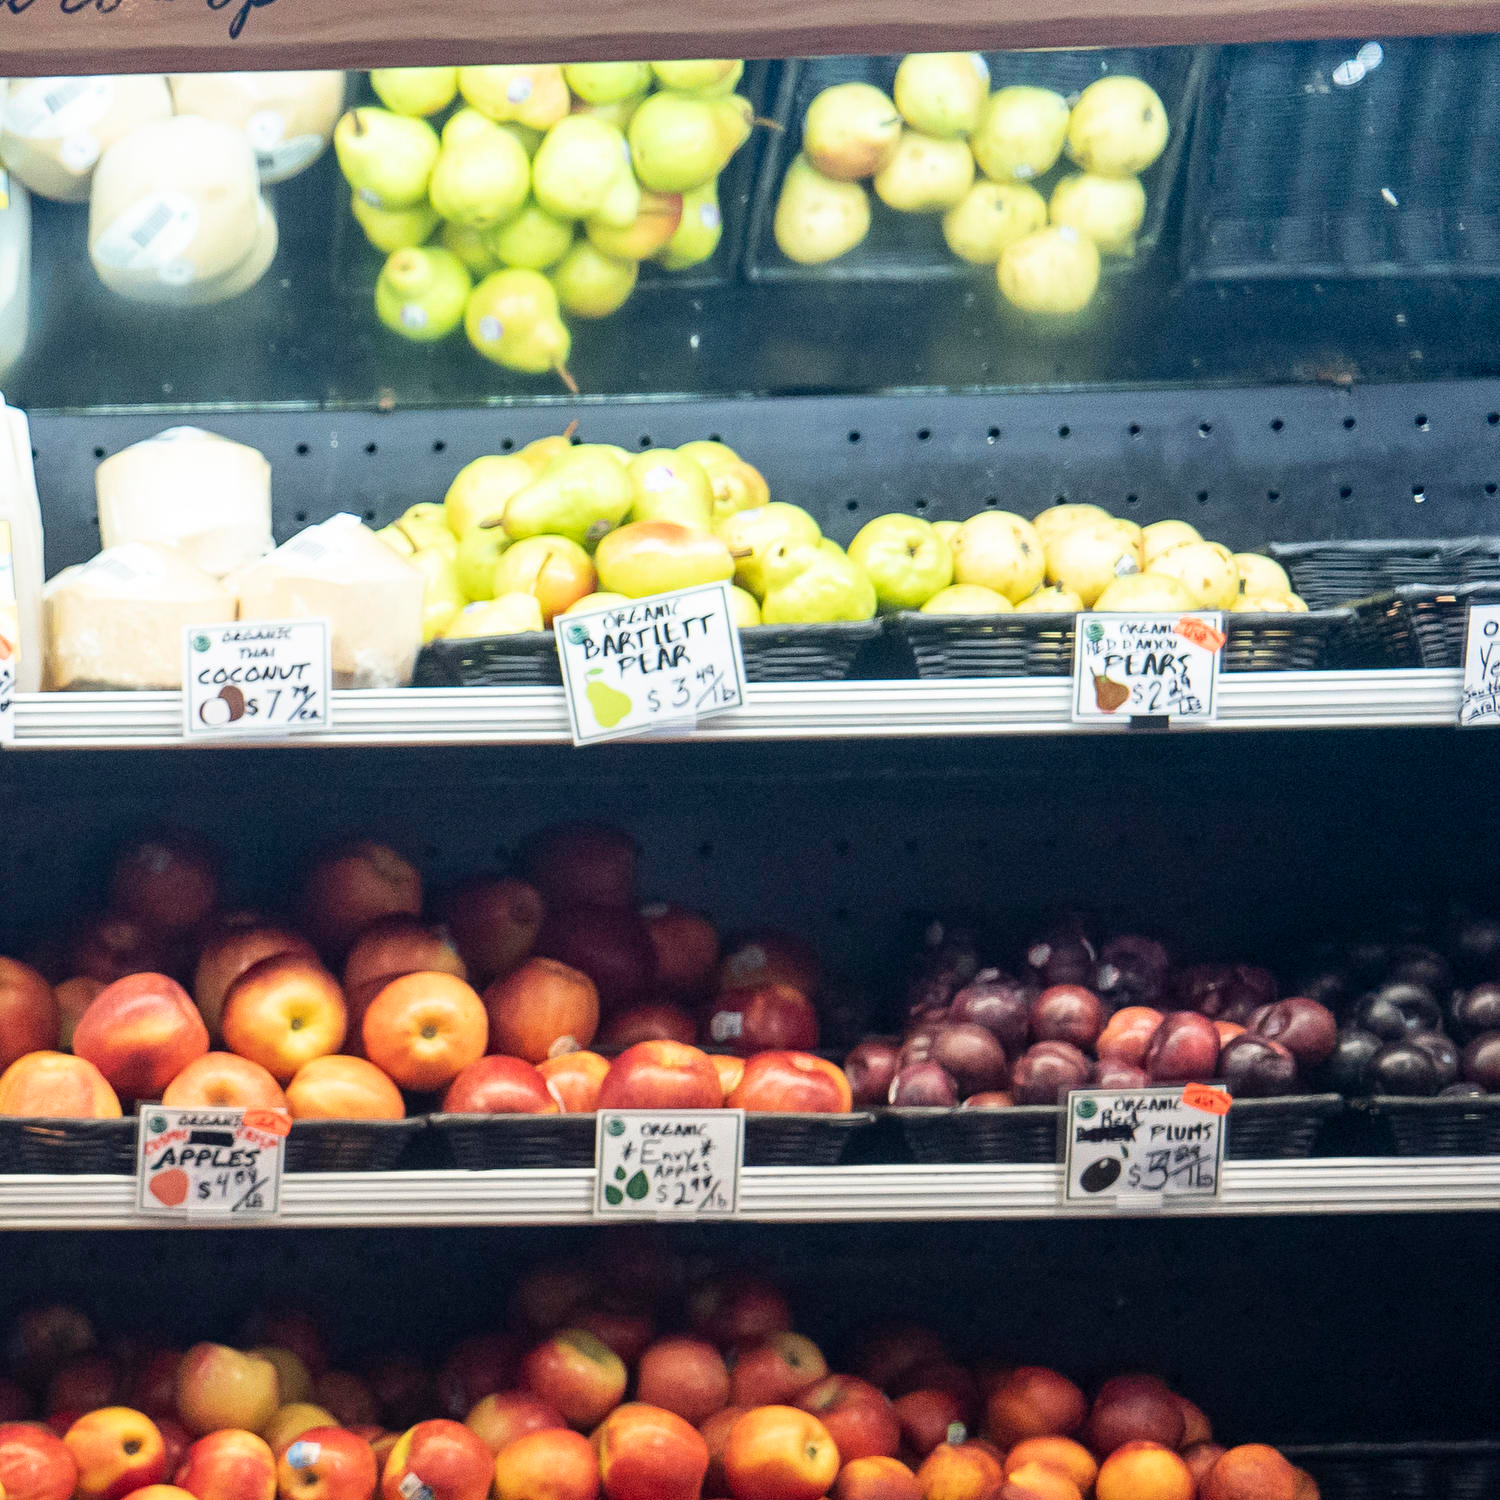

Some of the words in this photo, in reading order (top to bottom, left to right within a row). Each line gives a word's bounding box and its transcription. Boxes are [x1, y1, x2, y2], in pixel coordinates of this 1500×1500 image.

[603, 599, 681, 629] ORGANIC
[583, 613, 715, 660] BARTLETT
[240, 647, 276, 659] THAI
[618, 645, 692, 679] PEAR
[1104, 653, 1192, 677] PEARS
[198, 663, 312, 685] COCONUT
[1113, 1098, 1183, 1112] ORGANIC
[1150, 1122, 1214, 1142] PLUMS
[151, 1147, 261, 1171] APPLES
